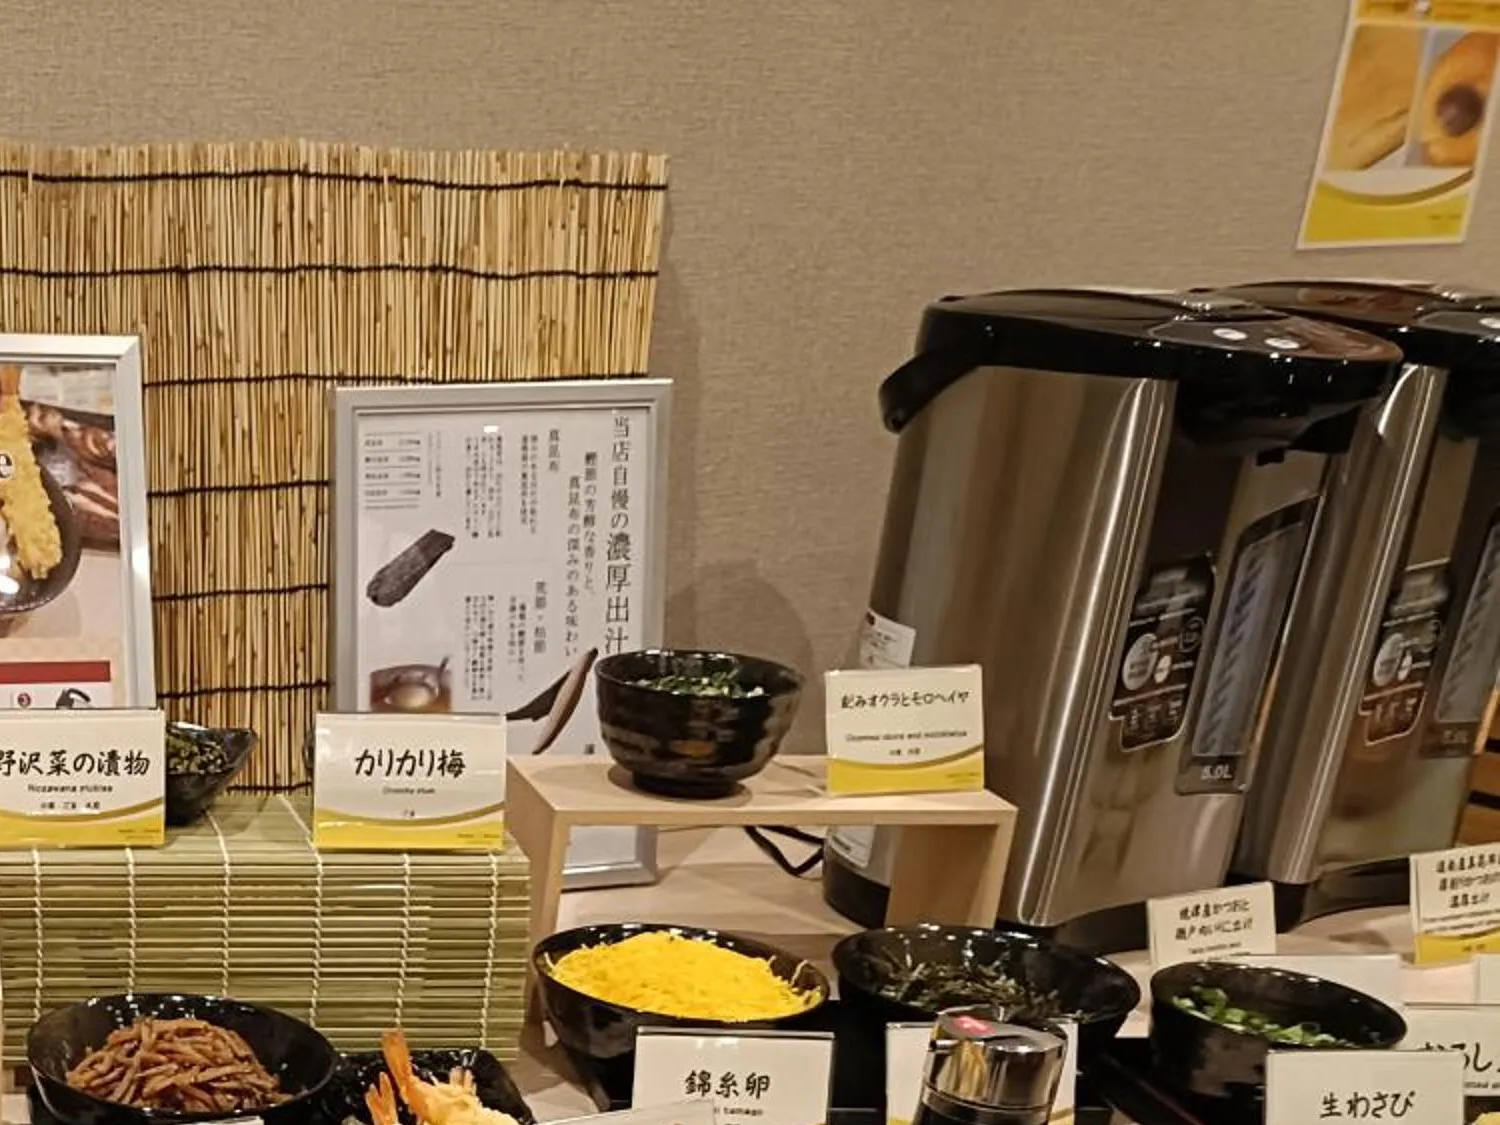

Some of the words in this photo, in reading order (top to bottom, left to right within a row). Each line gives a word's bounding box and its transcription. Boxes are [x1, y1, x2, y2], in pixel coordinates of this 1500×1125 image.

[355, 749, 466, 778] かりかり梅
[684, 1069, 771, 1099] 錦糸卵
[1319, 1090, 1416, 1119] 生わさび
